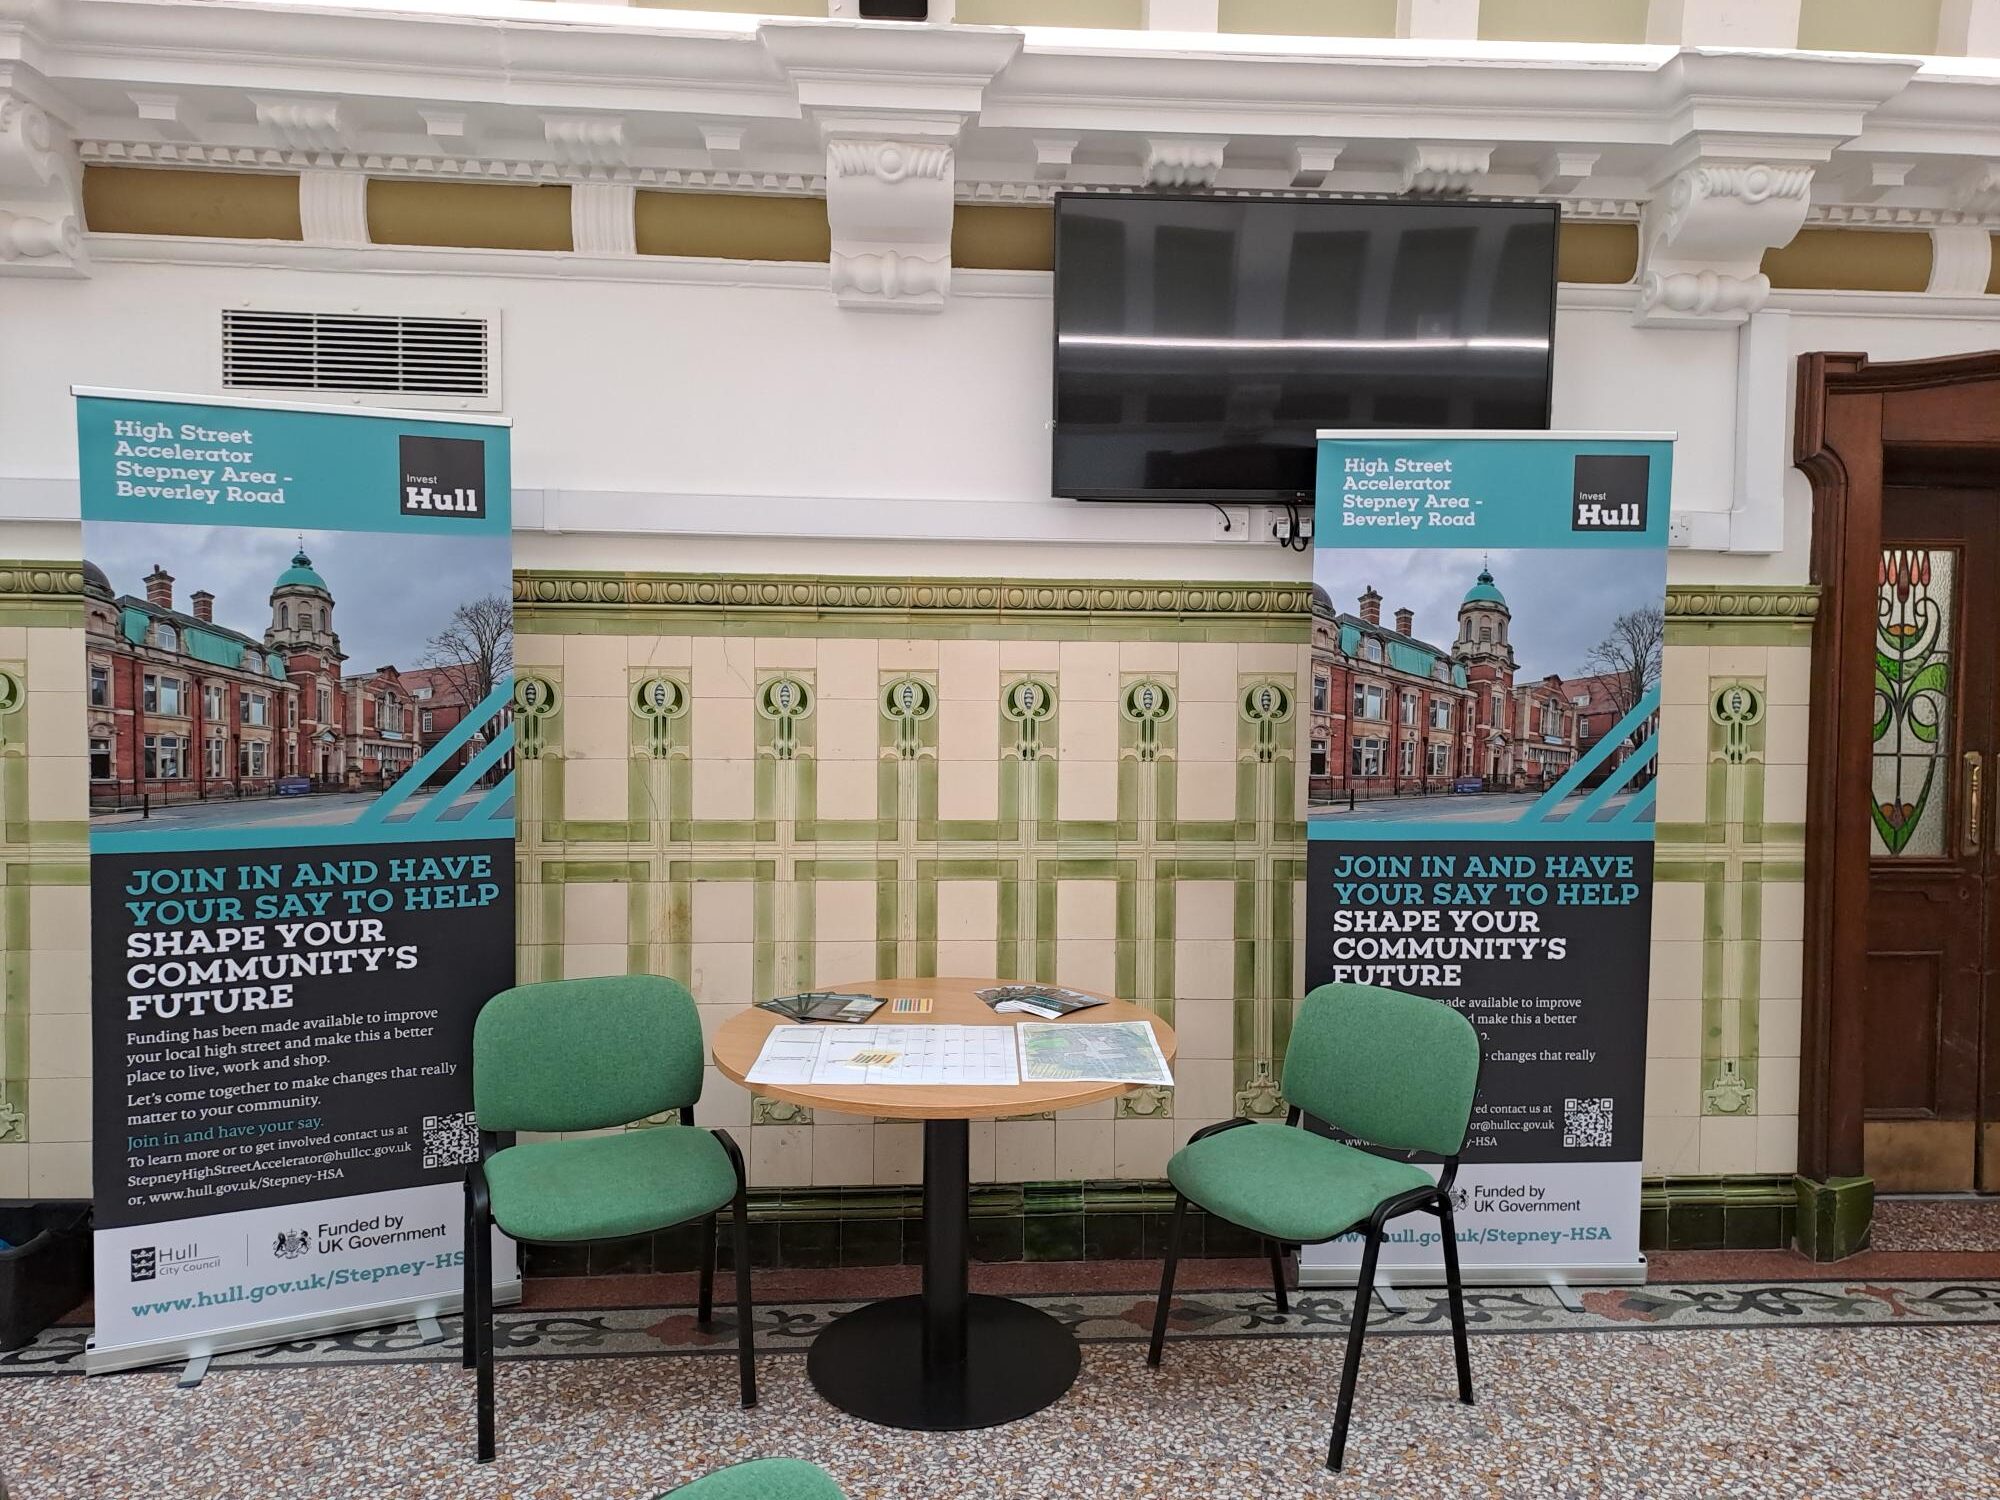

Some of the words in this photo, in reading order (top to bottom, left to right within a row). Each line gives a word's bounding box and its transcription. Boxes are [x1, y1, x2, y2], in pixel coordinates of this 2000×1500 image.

[114, 420, 173, 443] High
[180, 424, 252, 444] Street
[115, 440, 253, 464] Accelerator
[116, 461, 213, 484] Stepney
[221, 466, 277, 484] Area
[407, 473, 437, 484] Invest
[1344, 458, 1388, 476] High
[1394, 458, 1452, 472] Street
[117, 481, 219, 504] Beverley
[227, 486, 285, 504] Road
[1343, 476, 1451, 490] Accelerator
[406, 487, 478, 512] Hull
[1343, 494, 1418, 511] Stepney
[1424, 494, 1469, 508] Area
[1579, 492, 1606, 501] Invest
[1342, 512, 1422, 529] Beverley
[1428, 512, 1475, 525] Road
[1578, 503, 1640, 526] Hull
[126, 867, 226, 896] JOIN
[238, 865, 279, 891] IN
[292, 861, 377, 888] AND
[388, 855, 491, 883] HAVE
[1334, 856, 1410, 879] JOIN
[1422, 856, 1456, 878] IN
[1464, 856, 1536, 878] AND
[1545, 856, 1633, 878] HAVE
[125, 896, 244, 926] YOUR
[255, 891, 336, 920] SAY
[343, 888, 393, 915] TO
[404, 883, 500, 912] HELP
[1334, 883, 1424, 905] YOUR
[1433, 883, 1497, 906] SAY
[1505, 883, 1548, 905] TO
[1557, 883, 1639, 905] HELP
[1334, 910, 1440, 933] SHAPE
[1448, 910, 1540, 933] YOUR
[126, 925, 265, 958] SHAPE
[275, 919, 385, 947] YOUR
[1333, 965, 1461, 987] FUTURE
[126, 984, 293, 1020] FUTURE
[1469, 997, 1518, 1008] available
[1521, 998, 1532, 1008] to
[1535, 997, 1581, 1010] improve
[127, 1030, 189, 1045] Funding
[193, 1027, 218, 1039] has
[222, 1024, 257, 1037] been
[261, 1018, 300, 1033] made
[303, 1013, 363, 1029] available
[367, 1013, 380, 1023] to
[384, 1008, 438, 1023] improve
[1477, 1013, 1508, 1024] make
[1511, 1013, 1531, 1024] this
[1535, 1016, 1540, 1024] a
[1544, 1013, 1577, 1024] better
[126, 1052, 161, 1066] your
[165, 1047, 200, 1061] local
[204, 1043, 237, 1058] high
[240, 1040, 280, 1053] street
[284, 1036, 310, 1049] and
[314, 1032, 351, 1046] make
[355, 1030, 380, 1042] this
[394, 1027, 434, 1039] better
[1491, 1050, 1537, 1063] changes
[1540, 1050, 1562, 1060] that
[1565, 1049, 1596, 1062] really
[126, 1070, 166, 1086] place
[170, 1069, 185, 1079] to
[189, 1064, 219, 1078] live,
[223, 1059, 259, 1073] work
[263, 1056, 289, 1070] and
[293, 1054, 330, 1067] shop.
[165, 1089, 205, 1103] come
[210, 1081, 270, 1099] together
[274, 1080, 288, 1091] to
[292, 1075, 329, 1089] make
[333, 1070, 387, 1084] changes
[391, 1067, 417, 1078] that
[421, 1062, 457, 1075] really
[128, 1112, 178, 1126] matter
[181, 1109, 196, 1120] to
[200, 1106, 234, 1120] your
[237, 1096, 321, 1112] community.
[1490, 1105, 1526, 1114] contact
[1529, 1106, 1540, 1114] us
[1543, 1106, 1552, 1114] at
[128, 1135, 159, 1152] Join
[164, 1132, 180, 1145] in
[184, 1127, 213, 1143] and
[218, 1125, 255, 1139] have
[258, 1120, 294, 1136] your
[297, 1117, 324, 1130] say.
[128, 1157, 144, 1168] To
[148, 1154, 182, 1166] learn
[185, 1148, 219, 1161] more
[223, 1146, 236, 1156] or
[240, 1144, 252, 1153] to
[256, 1141, 275, 1154] get
[278, 1134, 330, 1149] involved
[333, 1128, 377, 1141] contact
[381, 1128, 394, 1136] us
[397, 1126, 408, 1135] at
[128, 1142, 412, 1187] StepneyHighStreetAccelerator@hullcc.gov.uk
[128, 1194, 146, 1206] or,
[149, 1168, 344, 1203] www.hull.gov.uk/Stepney-HSA
[1475, 1186, 1526, 1197] Funded
[1529, 1186, 1545, 1200] by
[1474, 1201, 1494, 1212] UK
[1499, 1200, 1581, 1212] Government
[318, 1219, 379, 1238] Funded
[384, 1214, 404, 1230] by
[318, 1238, 344, 1254] UK
[348, 1224, 446, 1249] Government
[159, 1243, 198, 1263] Hull
[159, 1266, 179, 1276] City
[182, 1259, 221, 1272] Council
[130, 1251, 464, 1317] www.hull.gov.uk/Stepney-HS
